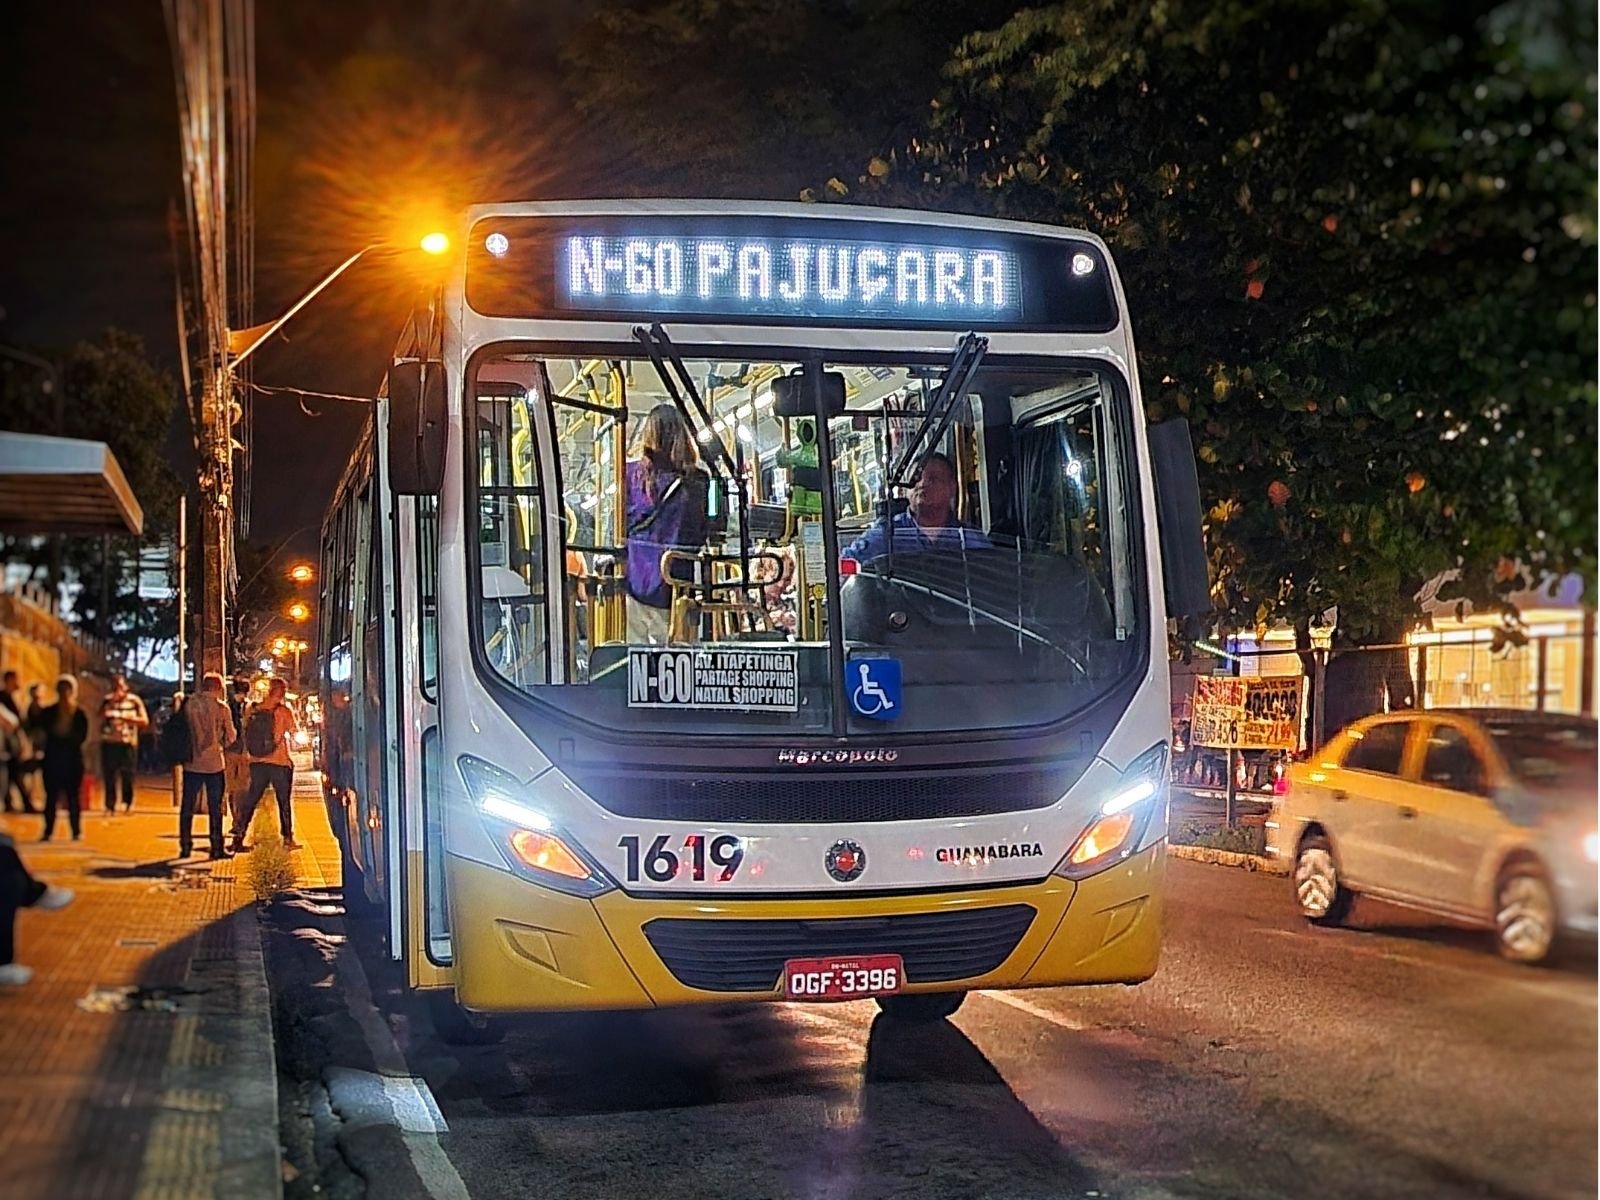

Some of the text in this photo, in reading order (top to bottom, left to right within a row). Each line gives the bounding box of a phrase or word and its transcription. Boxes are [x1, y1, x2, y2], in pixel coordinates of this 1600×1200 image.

[568, 236, 1005, 306] N-60 PAJUÇARA
[694, 653, 792, 671] AV. ITAPETINGA
[631, 653, 691, 703] N-60
[695, 670, 794, 687] PARTAGE SHOPPING
[695, 686, 794, 704] NATAL SHOPPING
[617, 833, 745, 882] 1619
[935, 842, 1044, 863] GUANABARA
